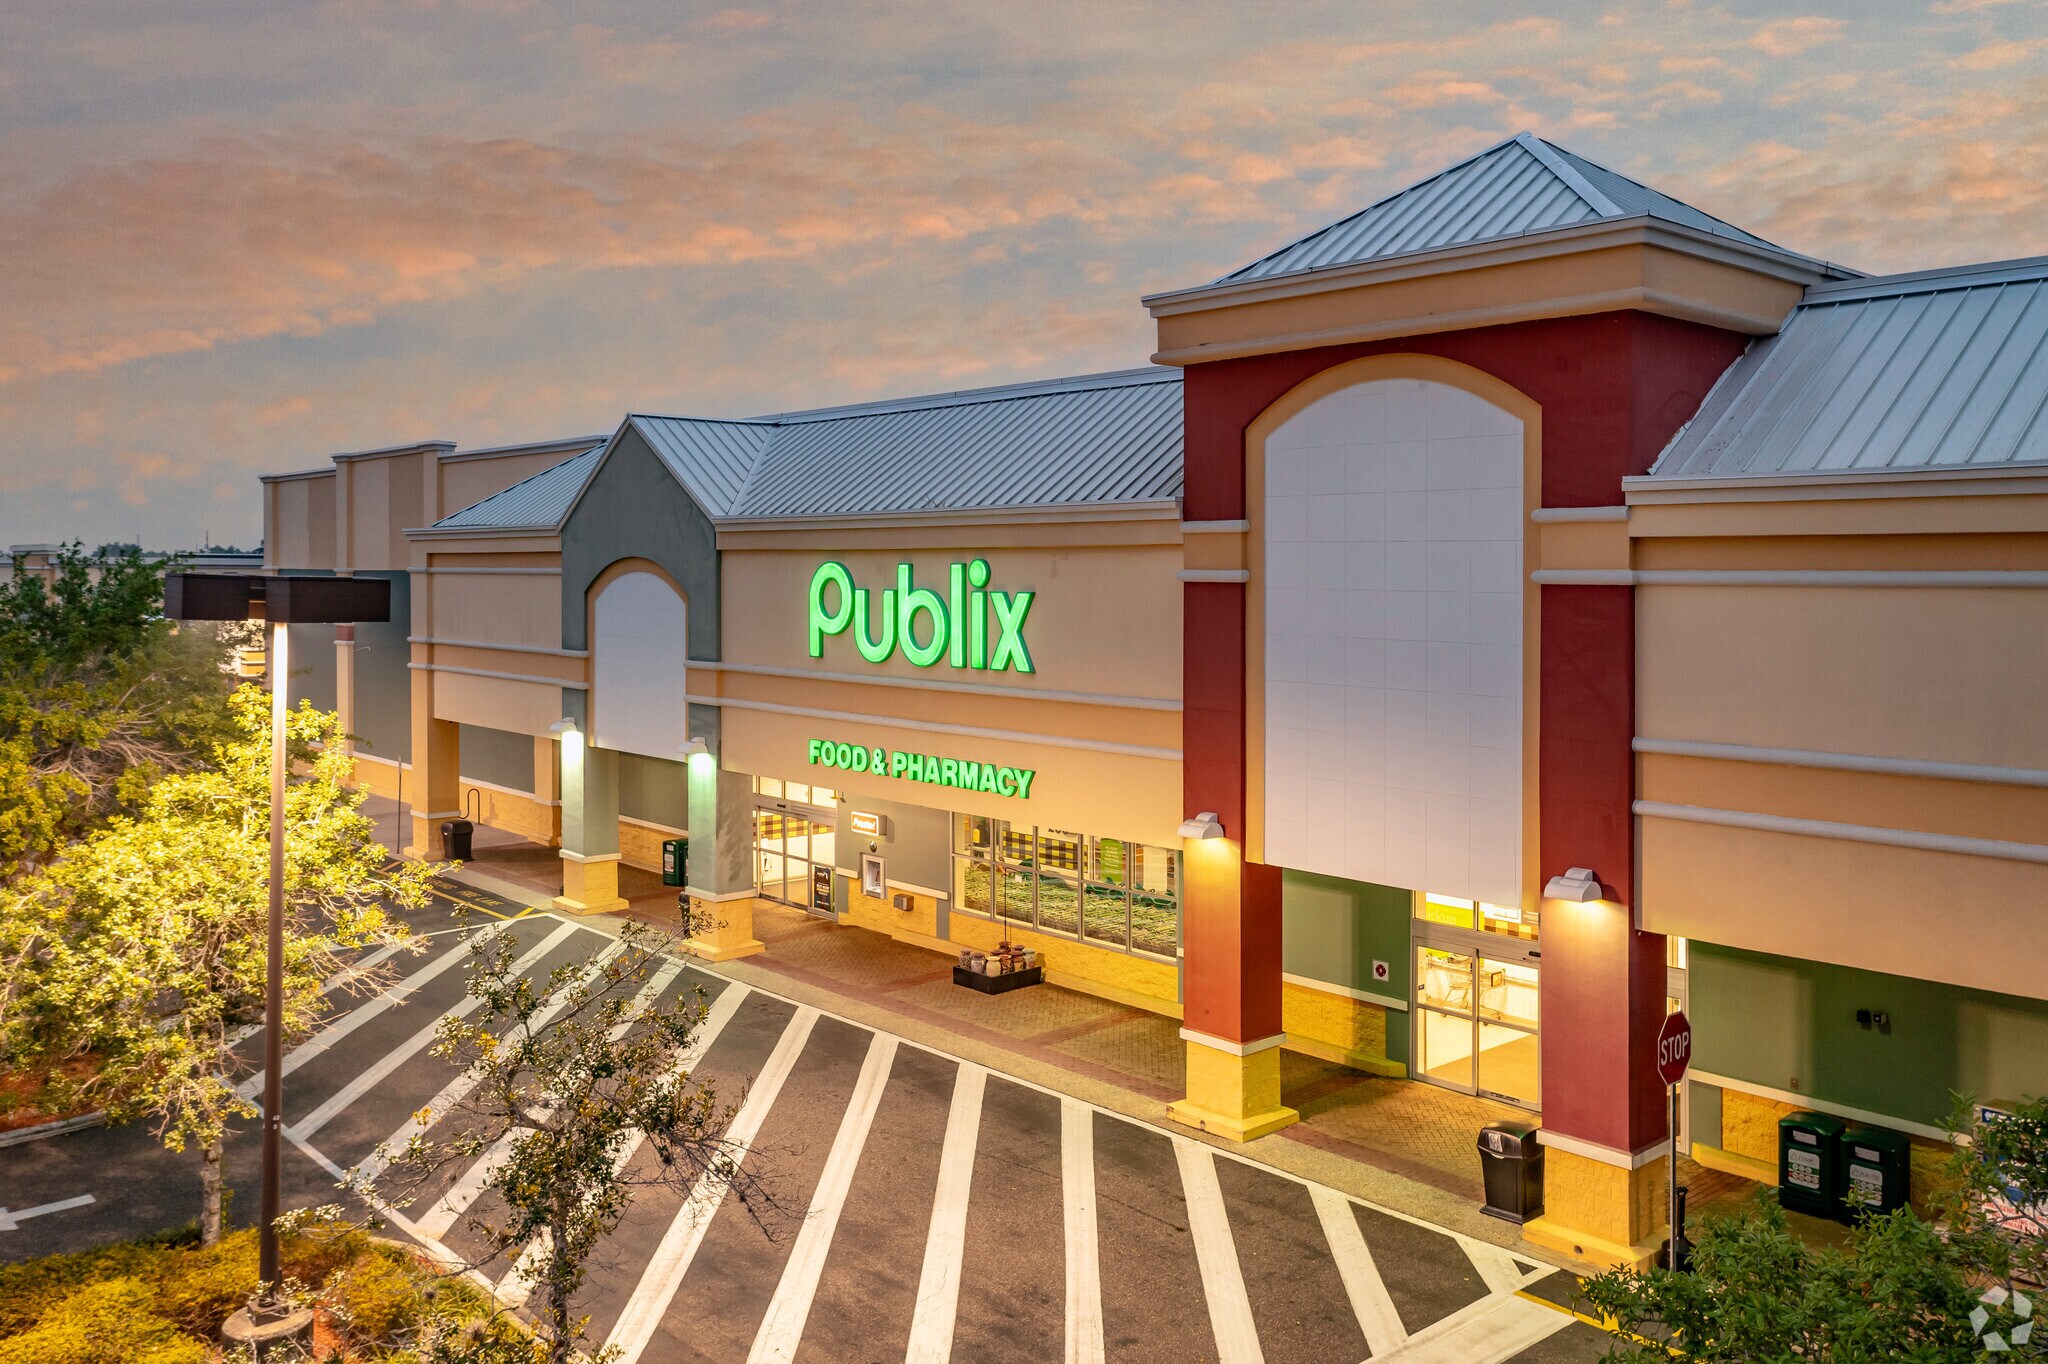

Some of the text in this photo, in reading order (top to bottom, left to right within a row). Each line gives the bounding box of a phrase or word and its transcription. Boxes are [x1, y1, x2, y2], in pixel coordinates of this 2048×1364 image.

[809, 558, 1036, 673] Publix
[809, 739, 1036, 799] FOOD & PHARMACY
[1427, 908, 1457, 925] ickup
[1660, 1031, 1689, 1066] STOP
